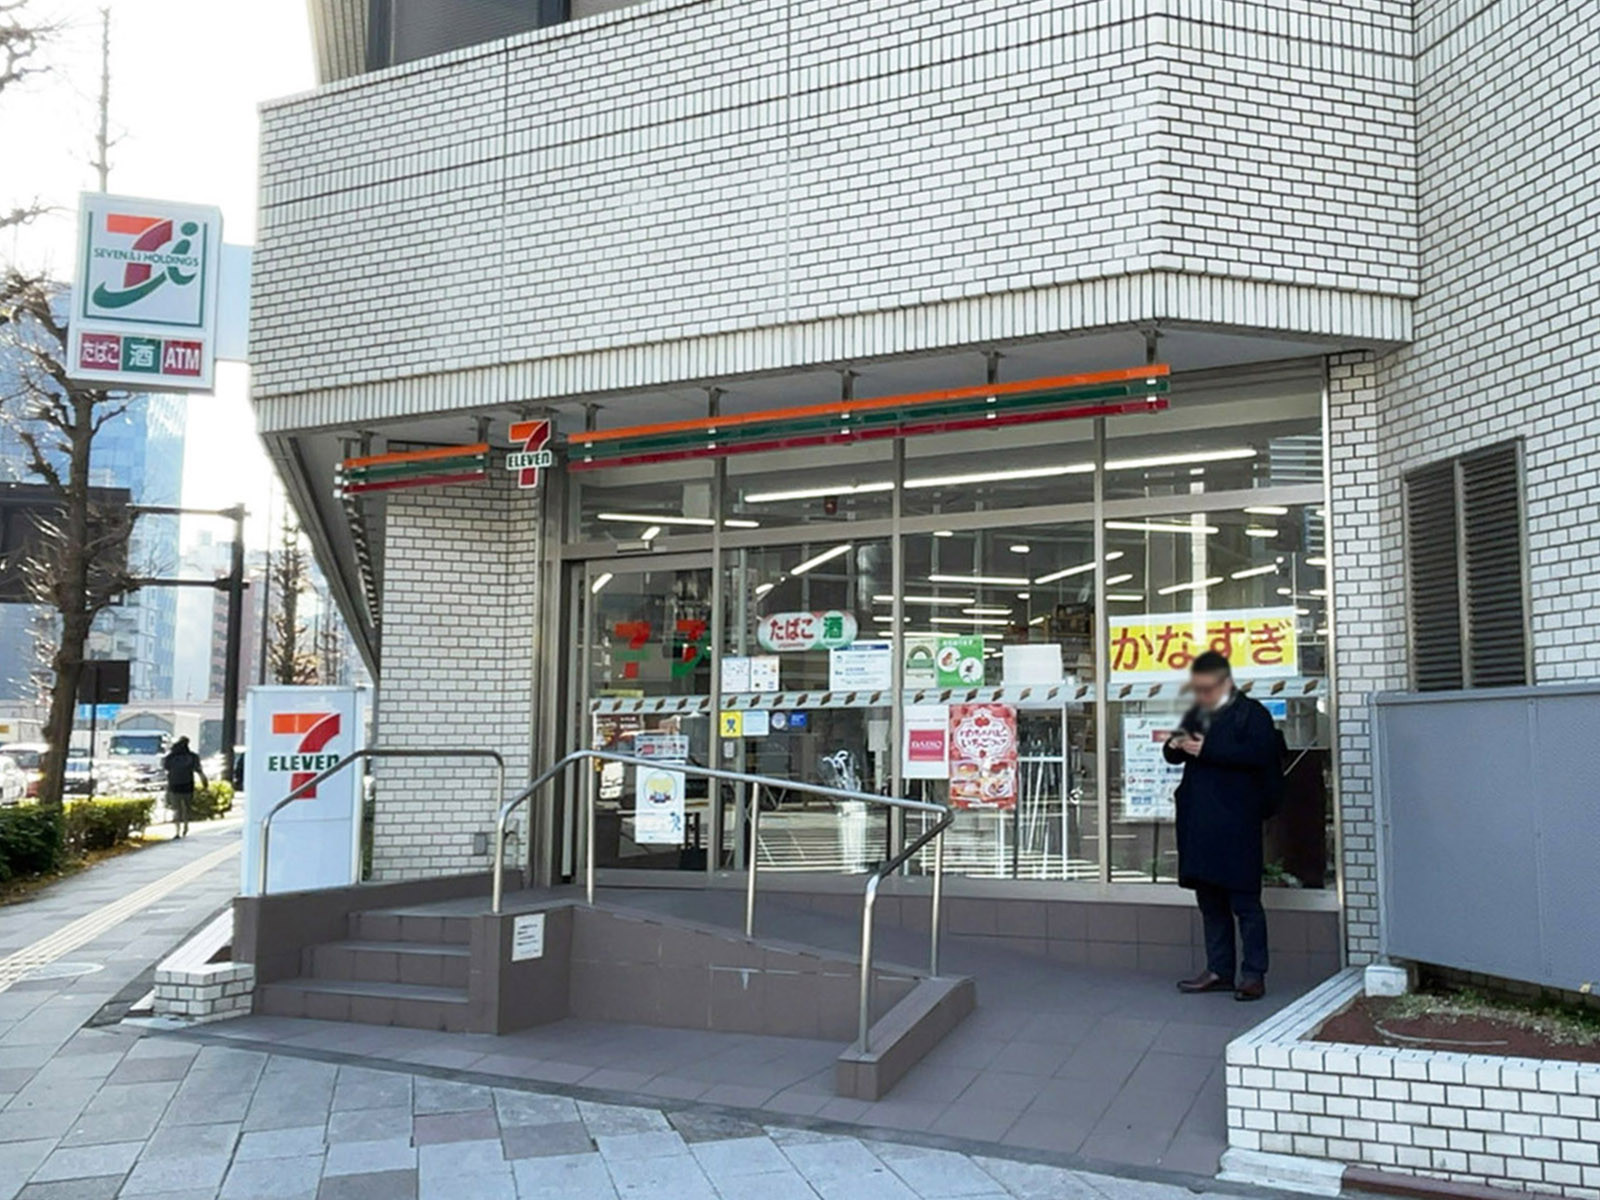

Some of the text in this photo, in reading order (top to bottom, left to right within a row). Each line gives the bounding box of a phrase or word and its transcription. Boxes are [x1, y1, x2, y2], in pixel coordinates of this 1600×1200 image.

[143, 252, 199, 267] HOLDINGS
[82, 341, 119, 363] たばこ
[129, 343, 155, 367] 酒
[164, 346, 200, 370] ATM
[509, 420, 550, 486] 7
[770, 618, 814, 641] たばこ
[823, 616, 843, 639] 酒
[1111, 619, 1293, 671] かなすぎ
[272, 713, 341, 799] 7
